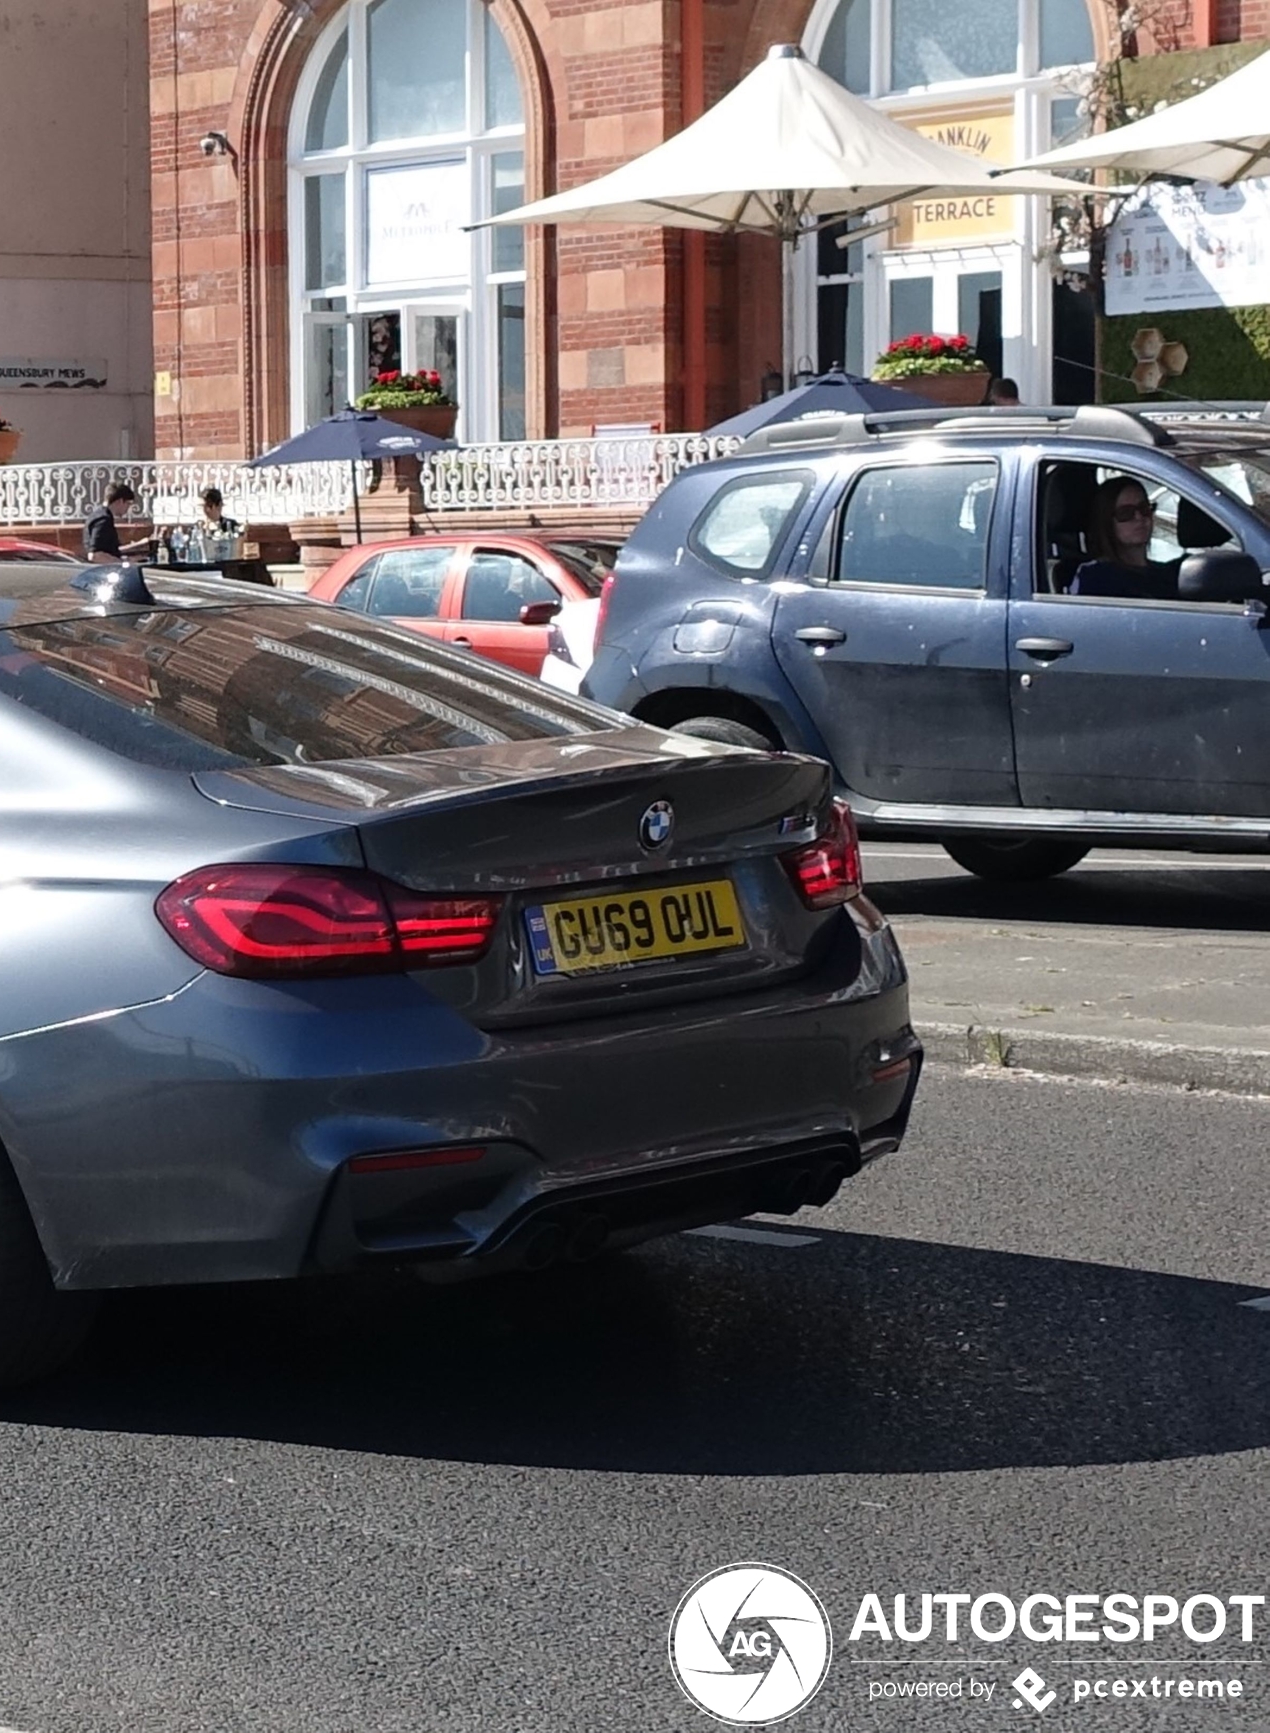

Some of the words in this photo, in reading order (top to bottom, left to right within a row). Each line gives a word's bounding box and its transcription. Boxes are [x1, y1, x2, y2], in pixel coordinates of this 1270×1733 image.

[929, 126, 991, 153] ANKLIN
[914, 198, 995, 223] TERRACE
[58, 368, 85, 379] MEWS
[554, 900, 655, 959] GU69
[661, 890, 734, 944] OUL
[538, 948, 553, 961] UK
